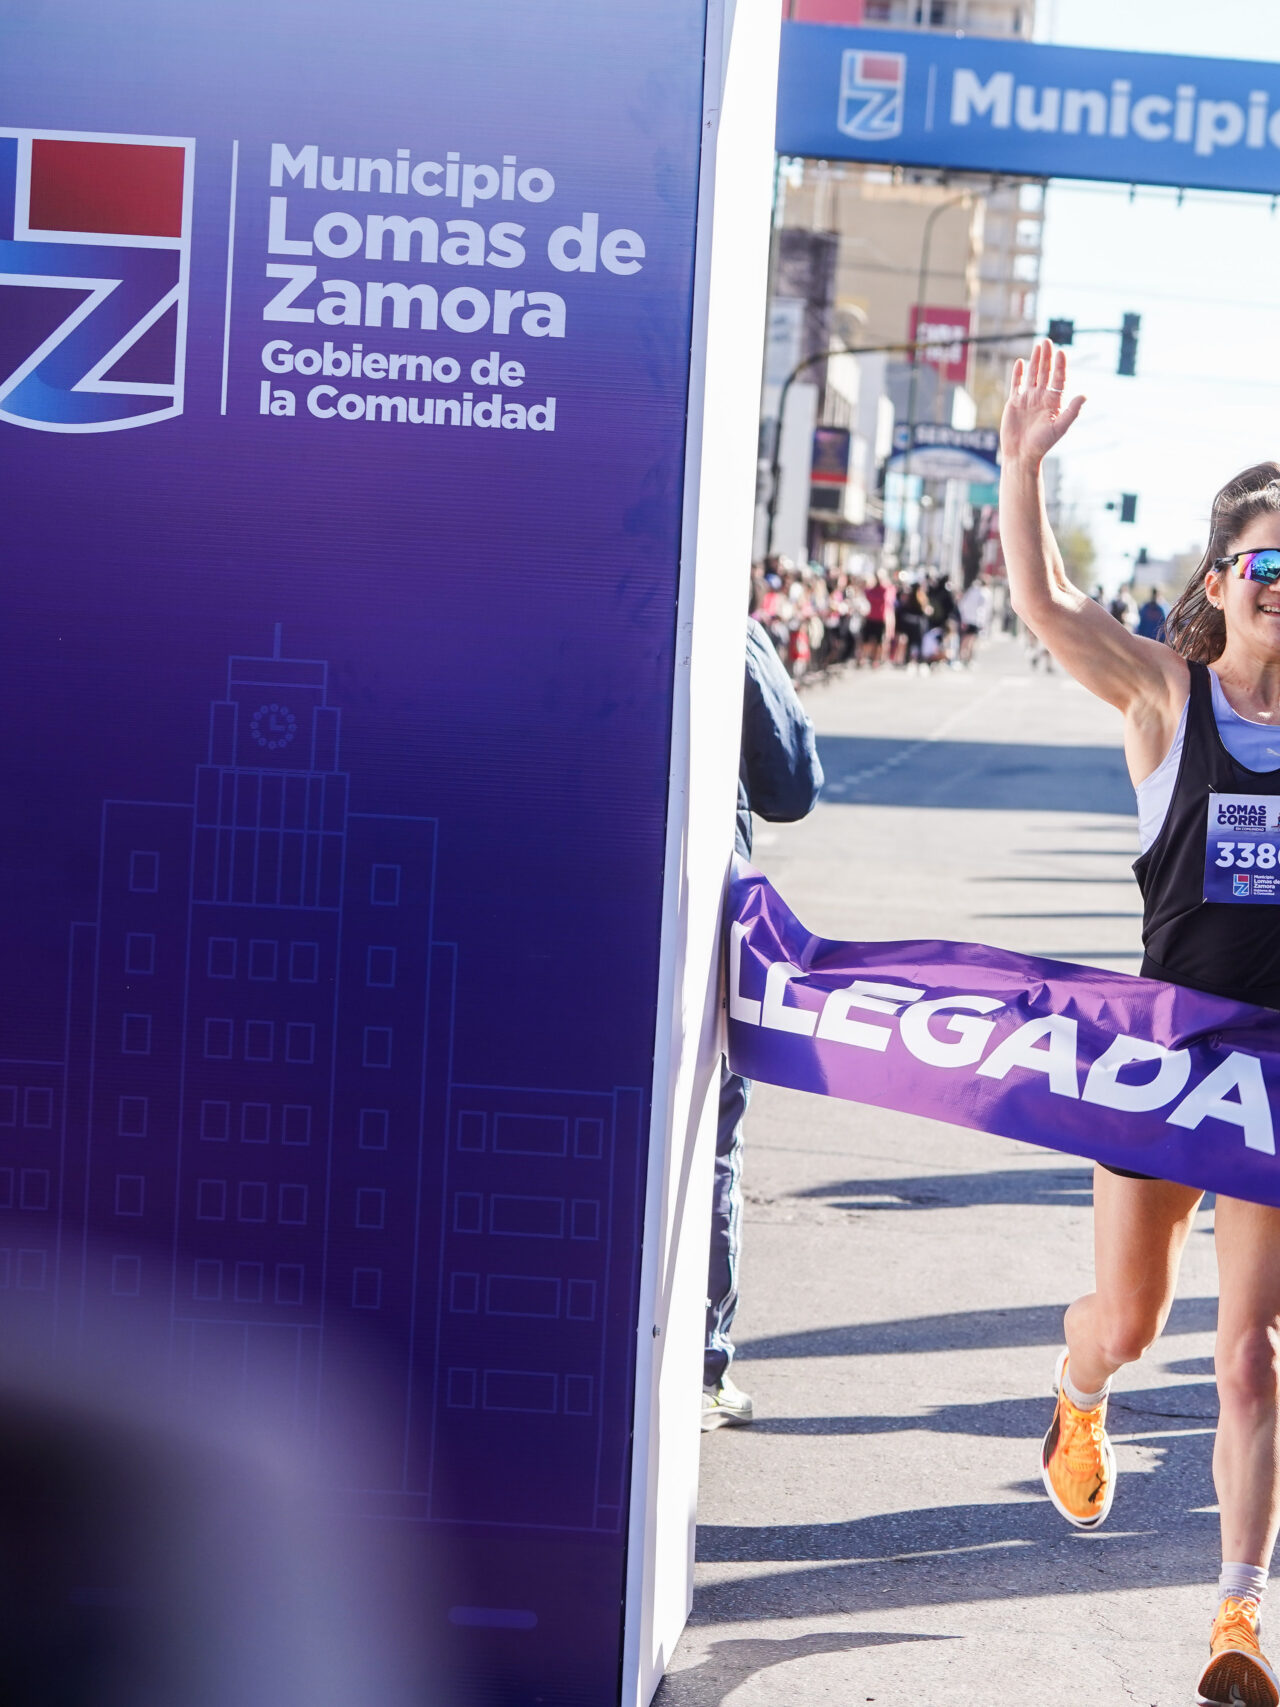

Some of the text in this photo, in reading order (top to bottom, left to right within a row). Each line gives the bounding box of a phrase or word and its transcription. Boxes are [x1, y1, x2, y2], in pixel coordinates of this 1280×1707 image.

[269, 142, 556, 209] Municipio
[267, 196, 646, 276] Lomas de
[262, 262, 567, 338] Zamora
[261, 339, 526, 388] Gobierno de
[259, 380, 557, 432] la Comunidad
[1217, 815, 1266, 826] CORRE
[1218, 804, 1266, 815] LOMAS
[729, 920, 1277, 1156] LLEGADA
